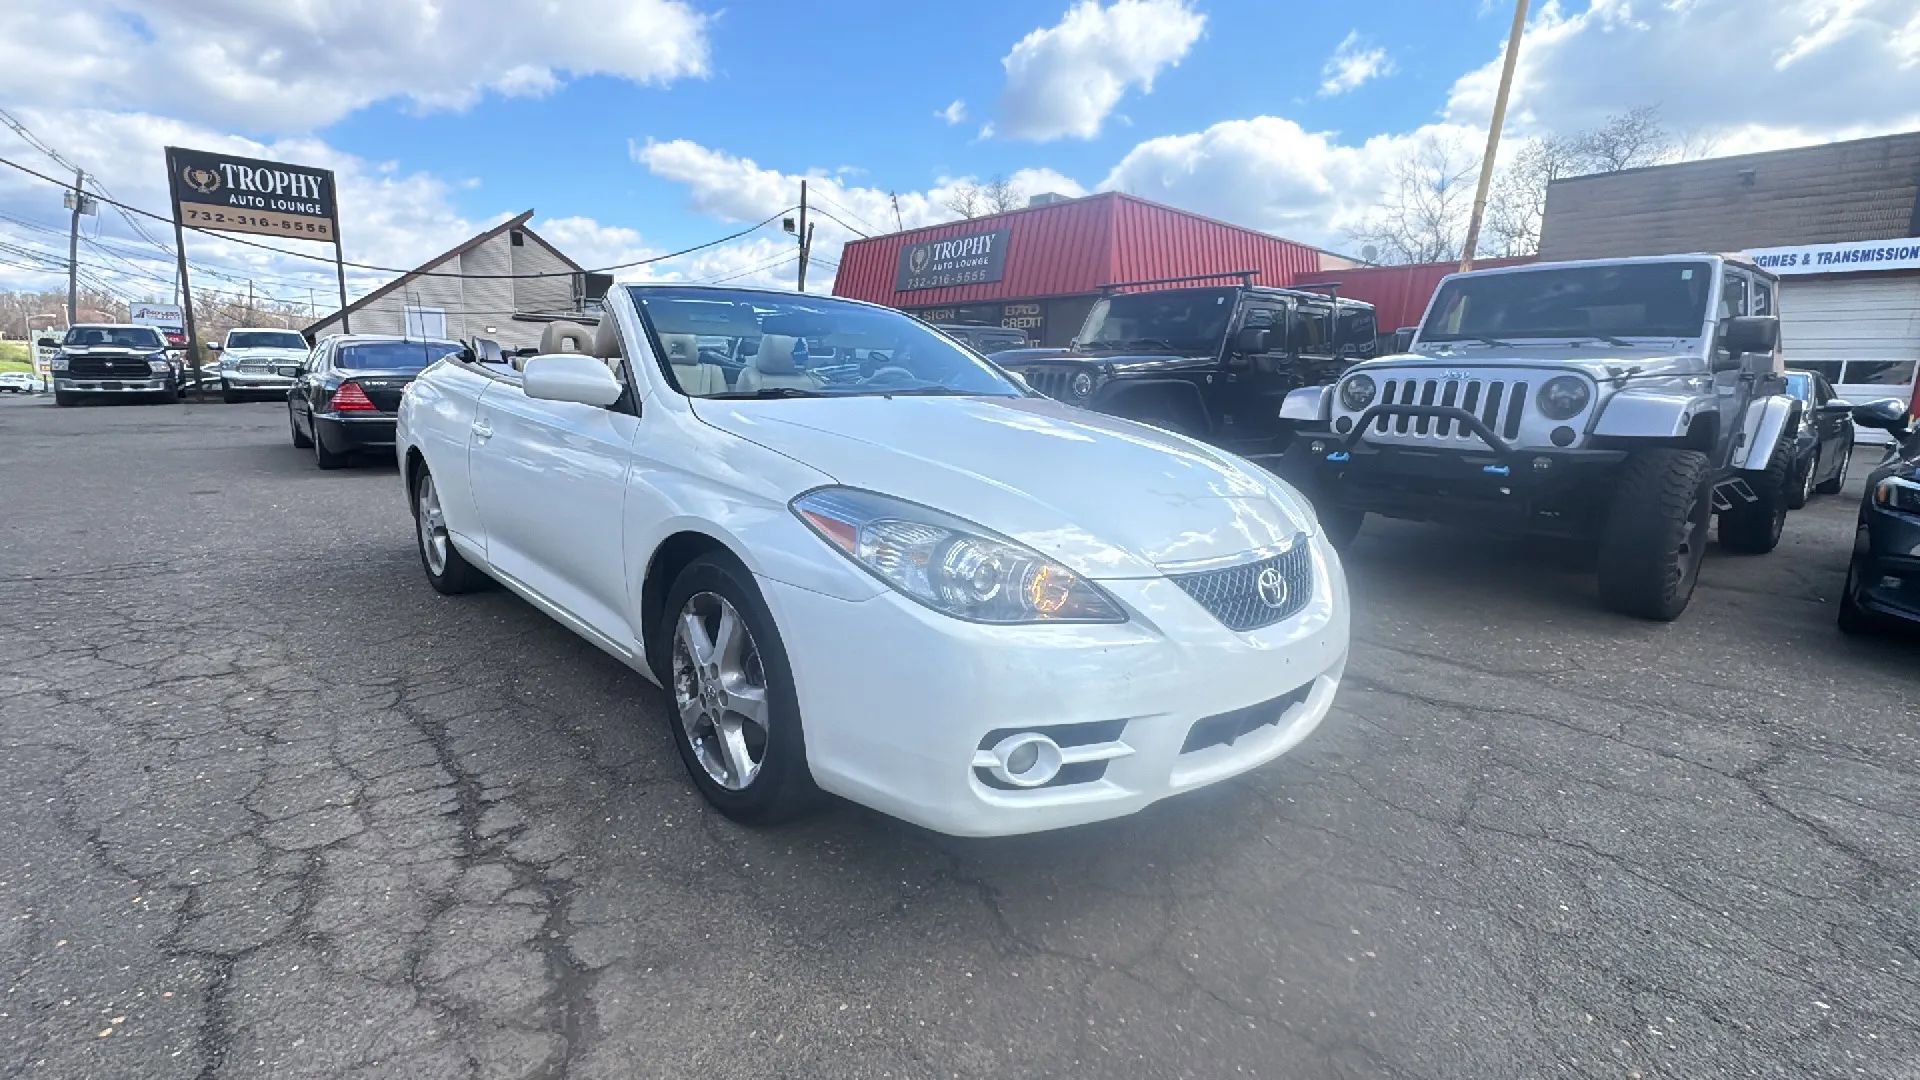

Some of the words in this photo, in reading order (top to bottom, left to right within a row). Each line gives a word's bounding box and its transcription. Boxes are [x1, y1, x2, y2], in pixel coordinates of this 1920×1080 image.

[220, 163, 322, 199] TROPHY
[229, 194, 265, 207] AUTO
[271, 199, 322, 214] LOUNGE
[187, 210, 327, 234] 732-316-5555
[933, 234, 996, 260] TROPHY
[932, 262, 953, 271] AUTO
[955, 257, 989, 269] LOUNGE
[1752, 254, 1797, 268] NGINES
[1802, 253, 1811, 266] &
[1001, 317, 1042, 329] CREDIT
